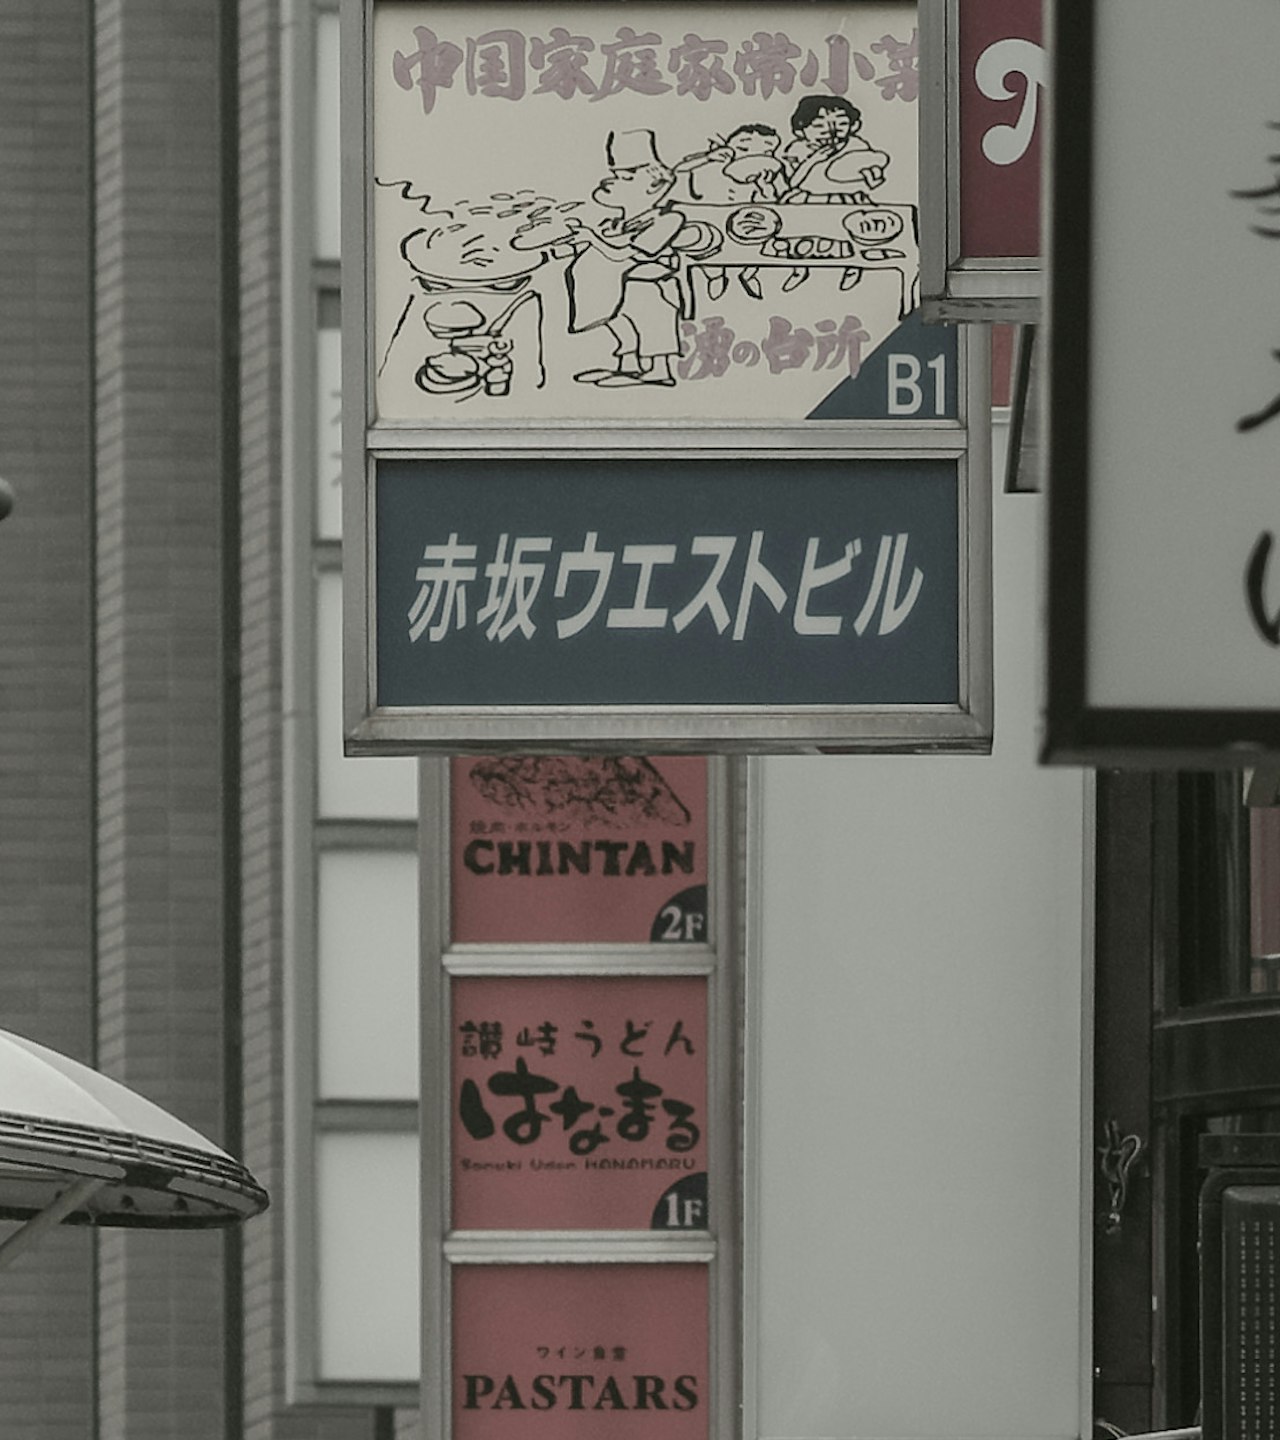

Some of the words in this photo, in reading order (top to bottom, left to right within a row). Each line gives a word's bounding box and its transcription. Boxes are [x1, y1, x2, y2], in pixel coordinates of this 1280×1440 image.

[887, 355, 946, 415] B1
[407, 530, 924, 644] 赤坂ウエストビル
[463, 840, 695, 876] CHINTAN
[661, 906, 704, 941] 2F
[460, 1020, 695, 1059] 讃岐うどん
[460, 1056, 700, 1155] はなまる
[666, 1194, 702, 1226] 1F
[463, 1375, 699, 1410] PASTARS
